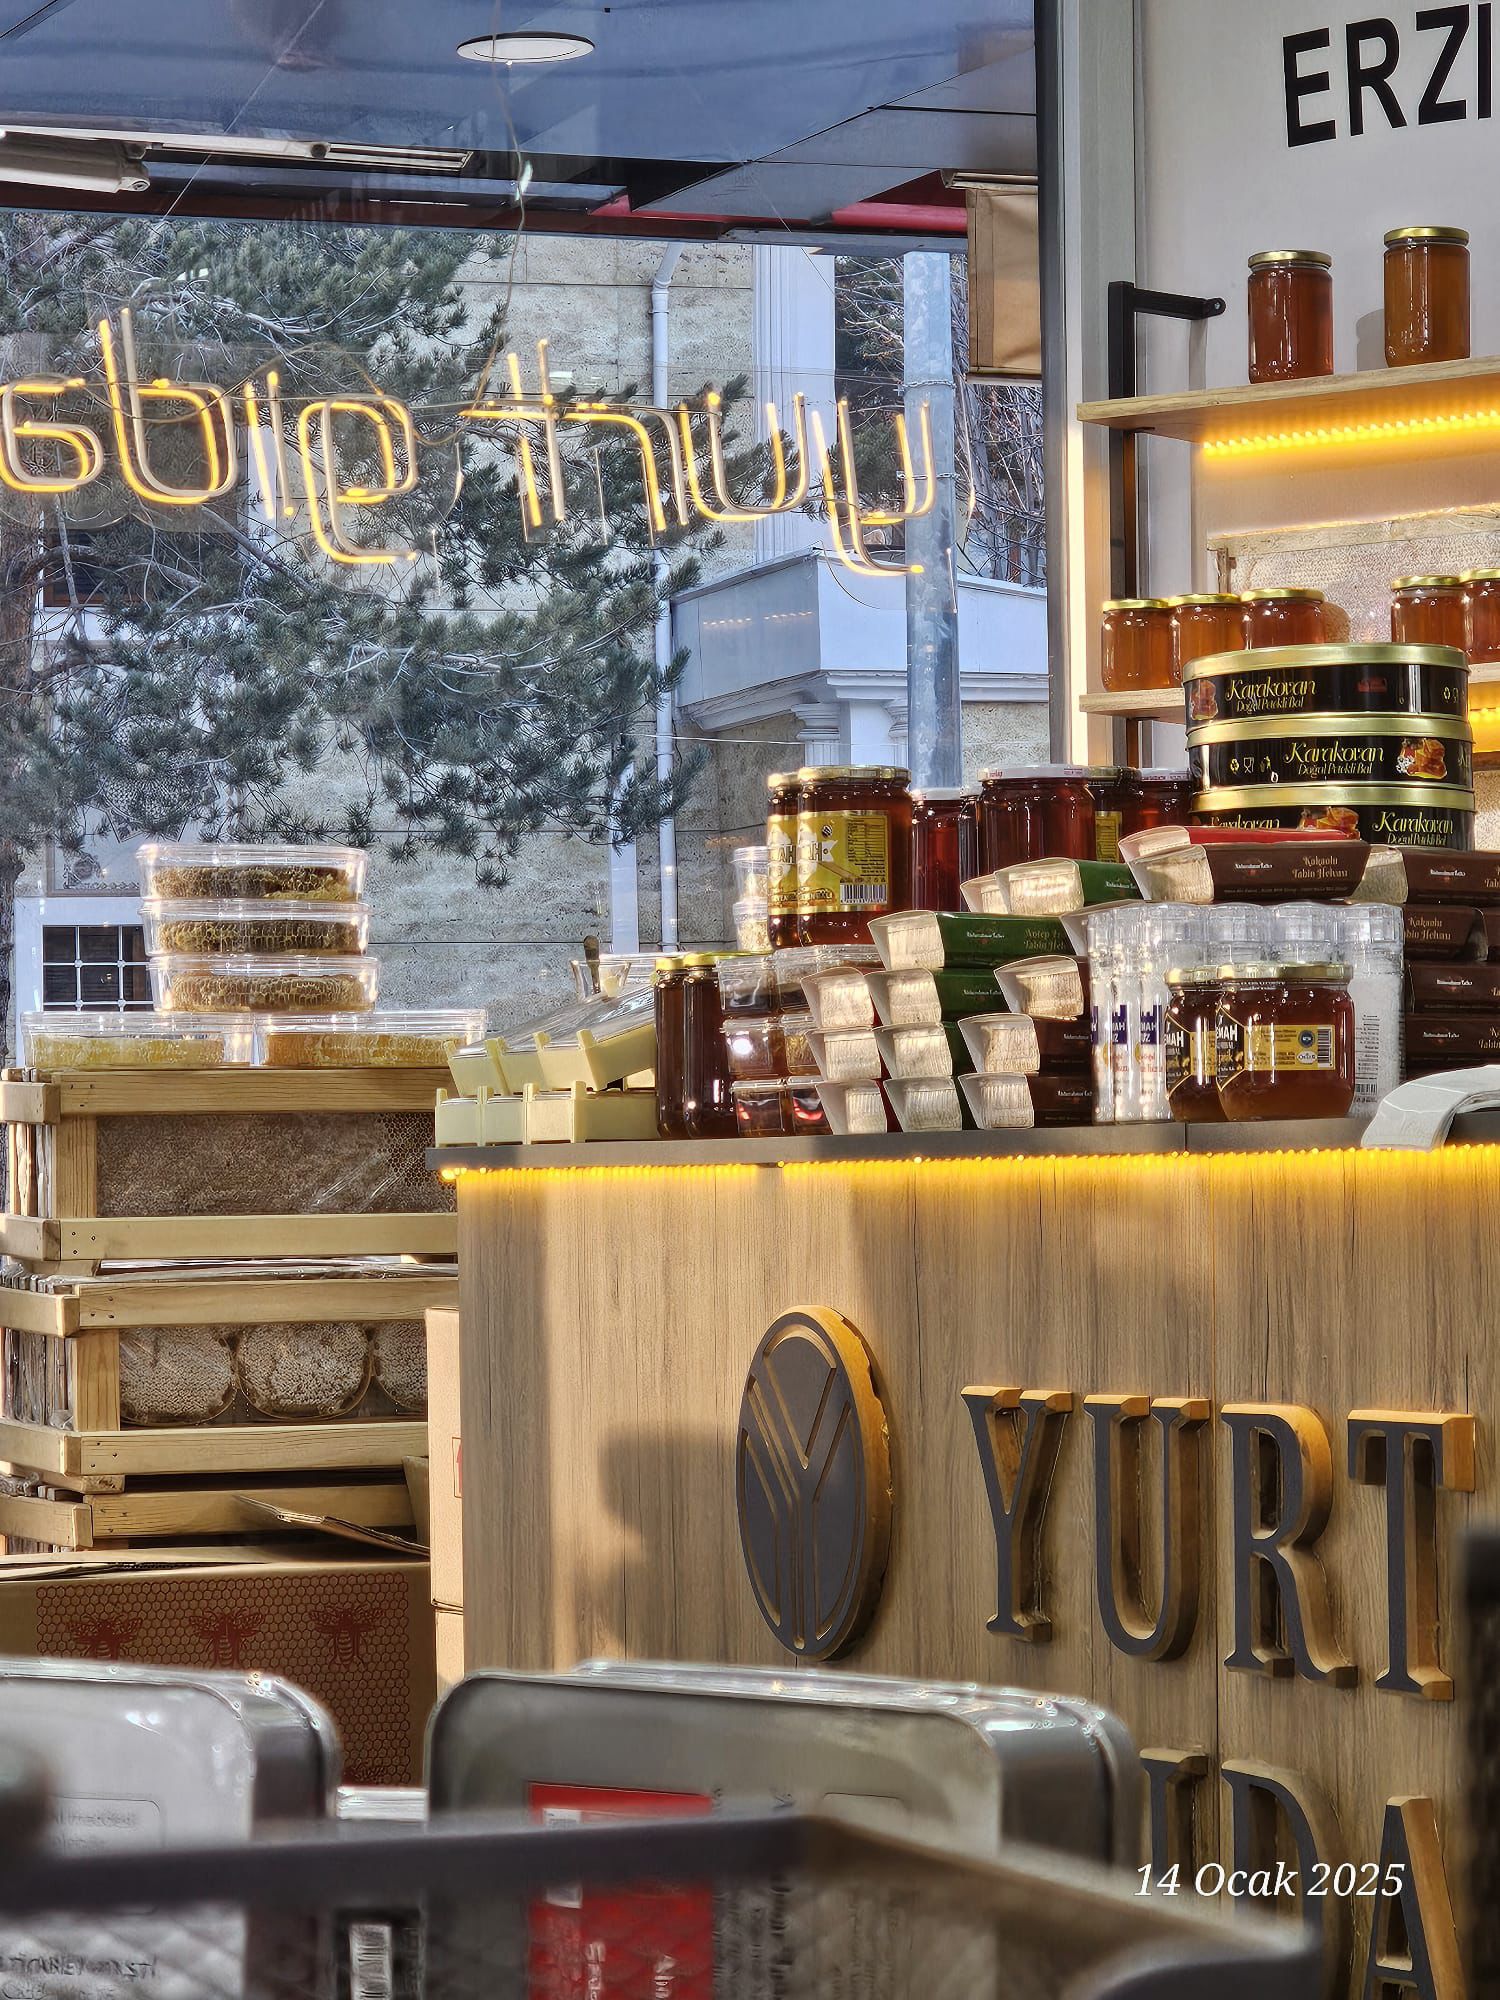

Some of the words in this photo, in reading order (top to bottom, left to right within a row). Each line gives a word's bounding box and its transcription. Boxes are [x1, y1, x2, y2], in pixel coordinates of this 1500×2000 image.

[1225, 676, 1316, 701] Karakovan
[1283, 741, 1385, 764] Karakovan
[1372, 810, 1453, 834] Karakovan
[960, 1385, 1477, 1701] YURT
